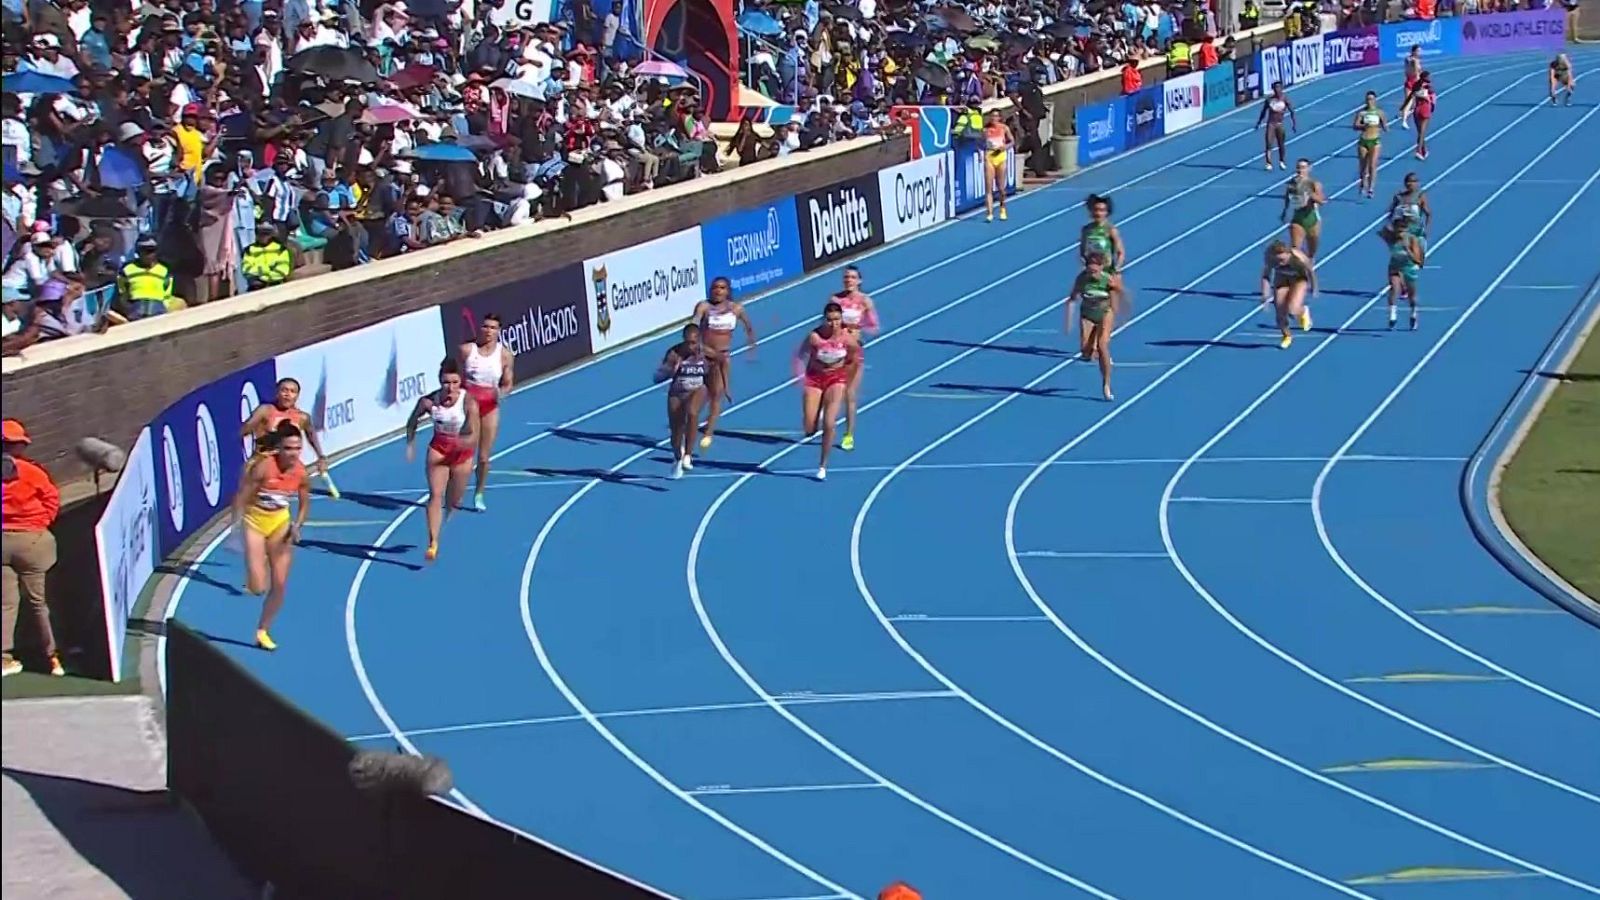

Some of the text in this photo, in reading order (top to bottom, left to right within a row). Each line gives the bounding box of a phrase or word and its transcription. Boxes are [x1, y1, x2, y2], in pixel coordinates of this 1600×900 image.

[1479, 19, 1563, 39] WORLD ATHLETICS
[1294, 41, 1320, 78] SONY
[1331, 38, 1350, 65] TDK
[895, 172, 939, 226] Corpay
[727, 229, 774, 267] DEBSWANA
[611, 281, 653, 311] Gaborone
[653, 268, 669, 301] City
[670, 258, 699, 292] Council
[497, 304, 579, 357] sent Masons
